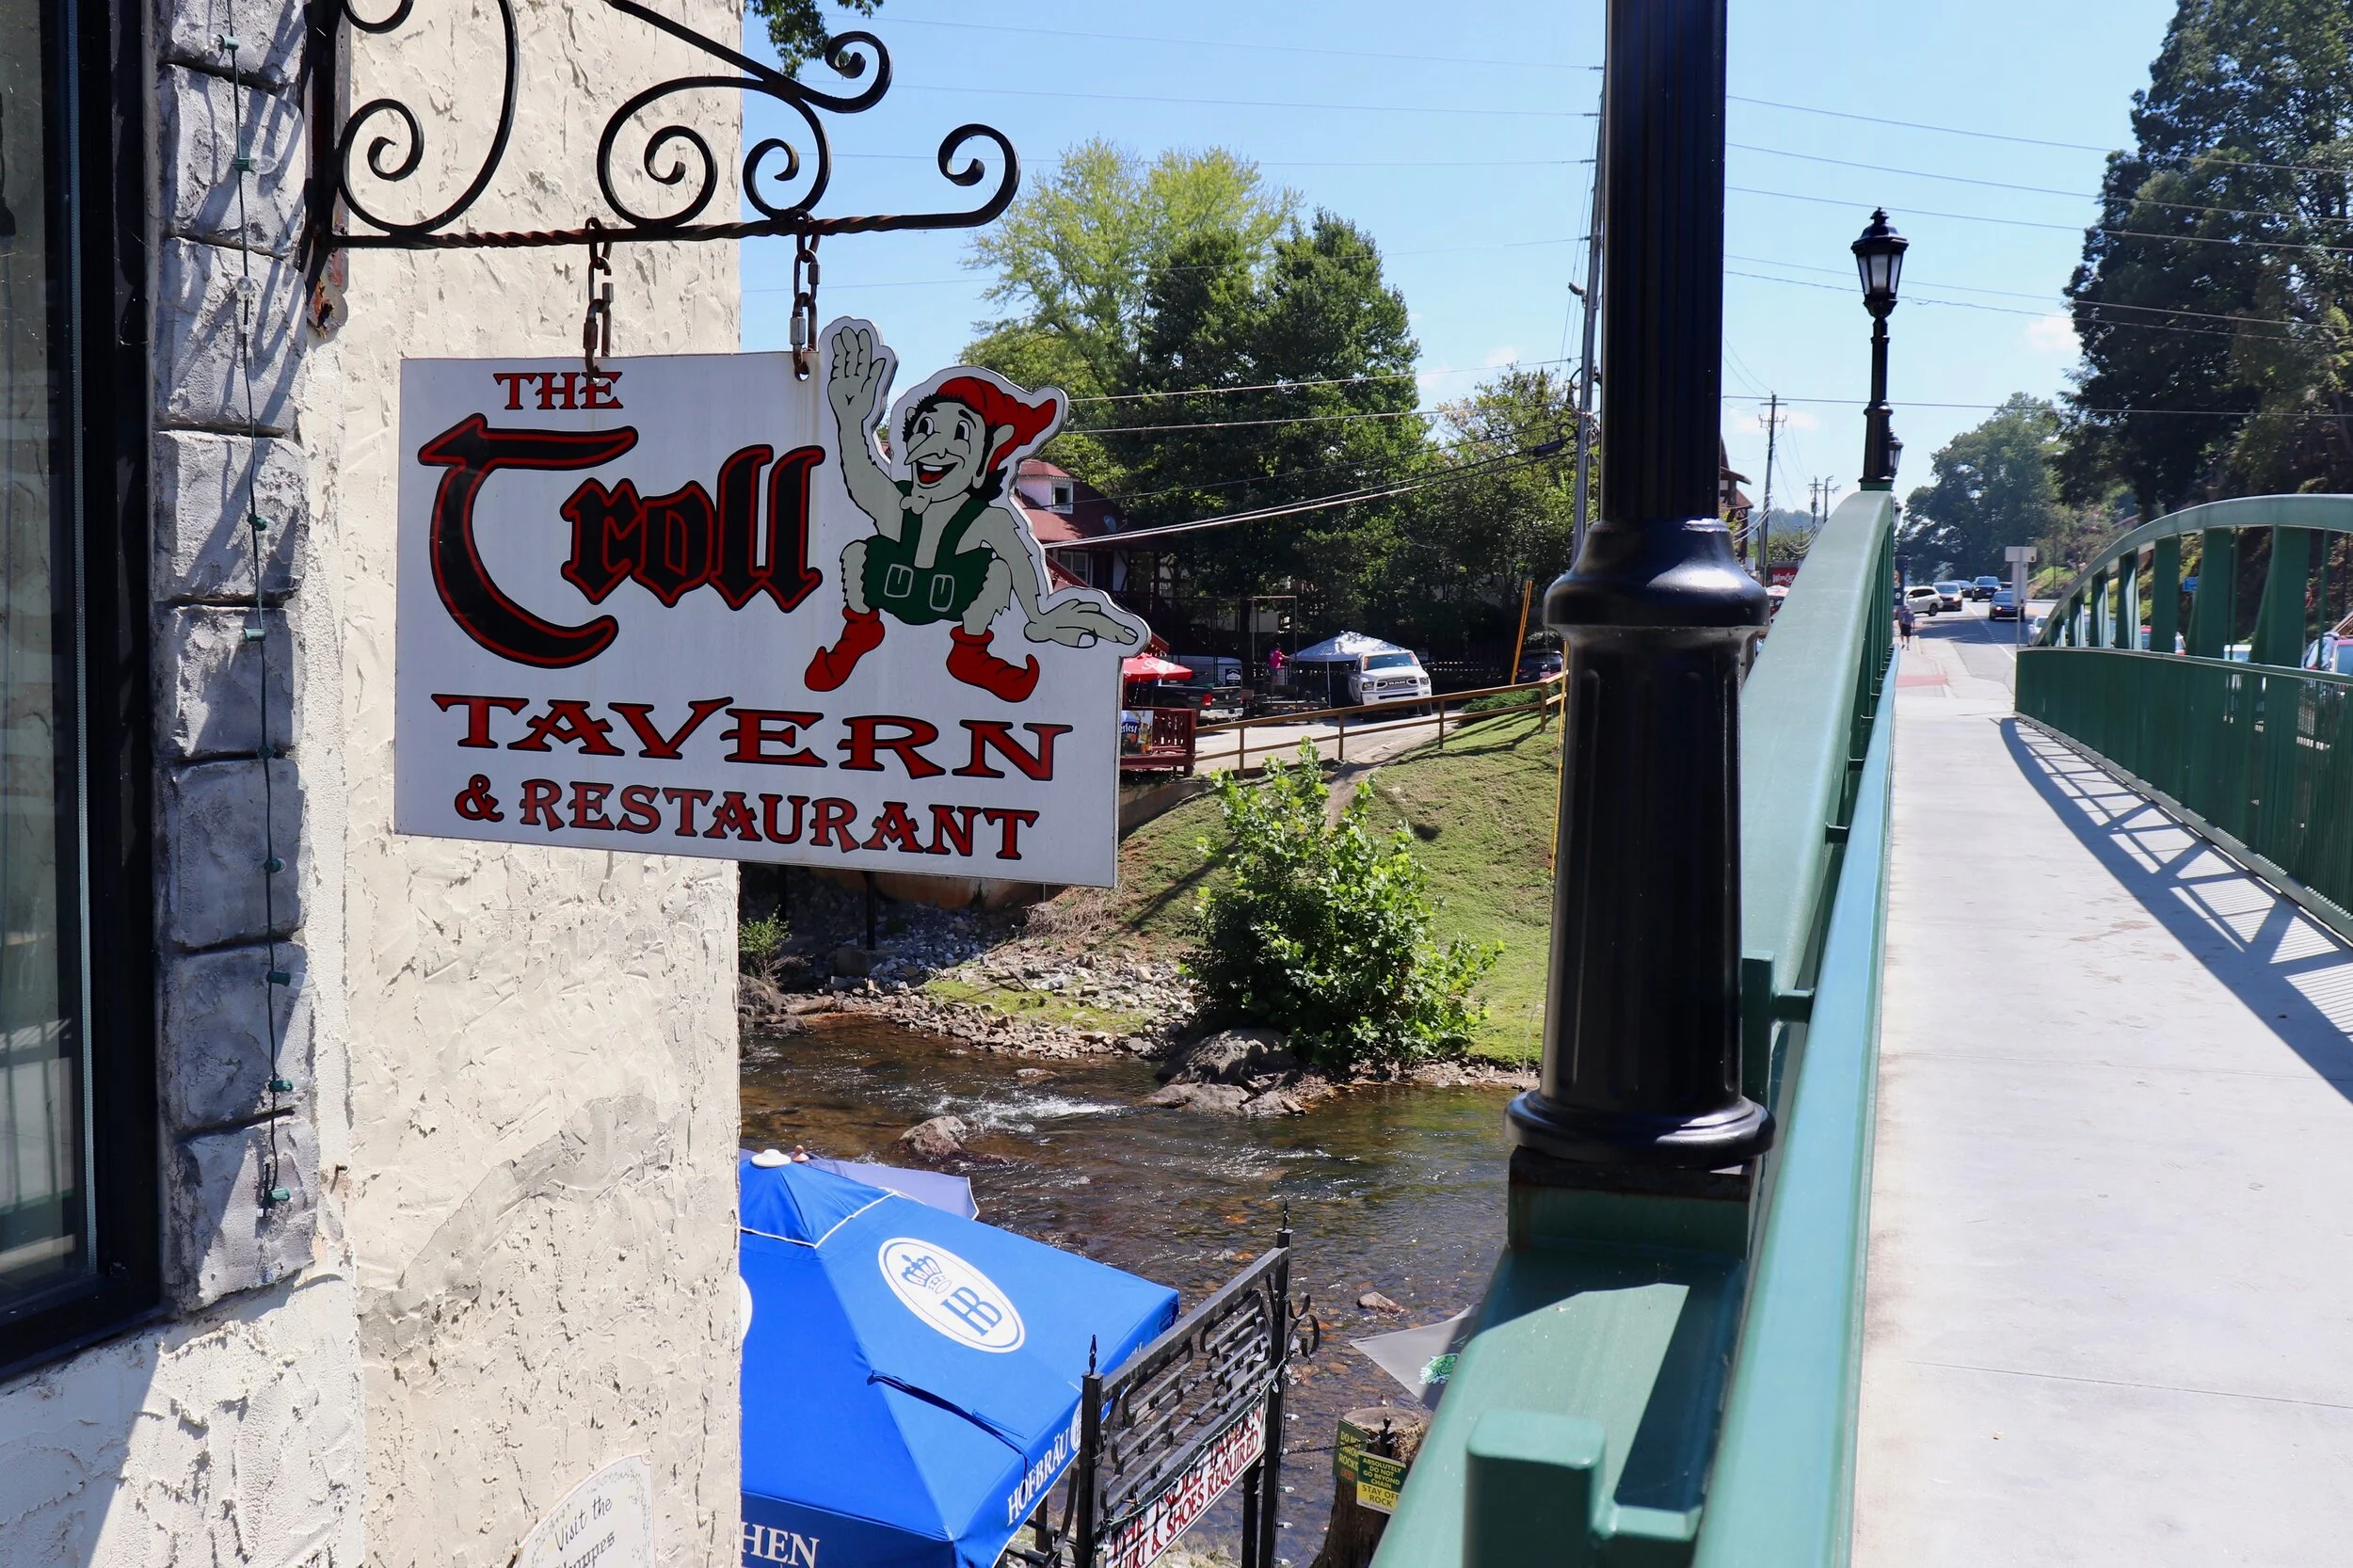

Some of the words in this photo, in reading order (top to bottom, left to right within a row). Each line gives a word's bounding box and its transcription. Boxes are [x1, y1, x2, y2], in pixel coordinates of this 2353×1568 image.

[493, 371, 625, 410] THE
[417, 412, 826, 669] Troll
[430, 693, 1074, 782] TAVERN
[454, 774, 504, 824] &
[520, 777, 1040, 862] RESTAURANT
[1340, 1431, 1350, 1442] DO
[1338, 1452, 1359, 1472] ROCKS
[1363, 1458, 1401, 1473] ABSOLUTELY
[1369, 1465, 1379, 1475] DO
[1381, 1468, 1394, 1478] NOT
[1006, 1427, 1070, 1528] HOFBRÄU
[1363, 1469, 1373, 1478] GO
[1374, 1473, 1401, 1486] BEYOND
[1370, 1478, 1392, 1489] CHAIN
[1151, 1531, 1163, 1556] &
[1166, 1483, 1205, 1543] SHOES
[1207, 1430, 1259, 1498] REQUIRED
[1362, 1484, 1383, 1496] STAY
[1385, 1490, 1400, 1501] OFF
[1369, 1494, 1393, 1508] ROCK
[554, 1509, 587, 1552] Visit
[592, 1496, 613, 1520] the
